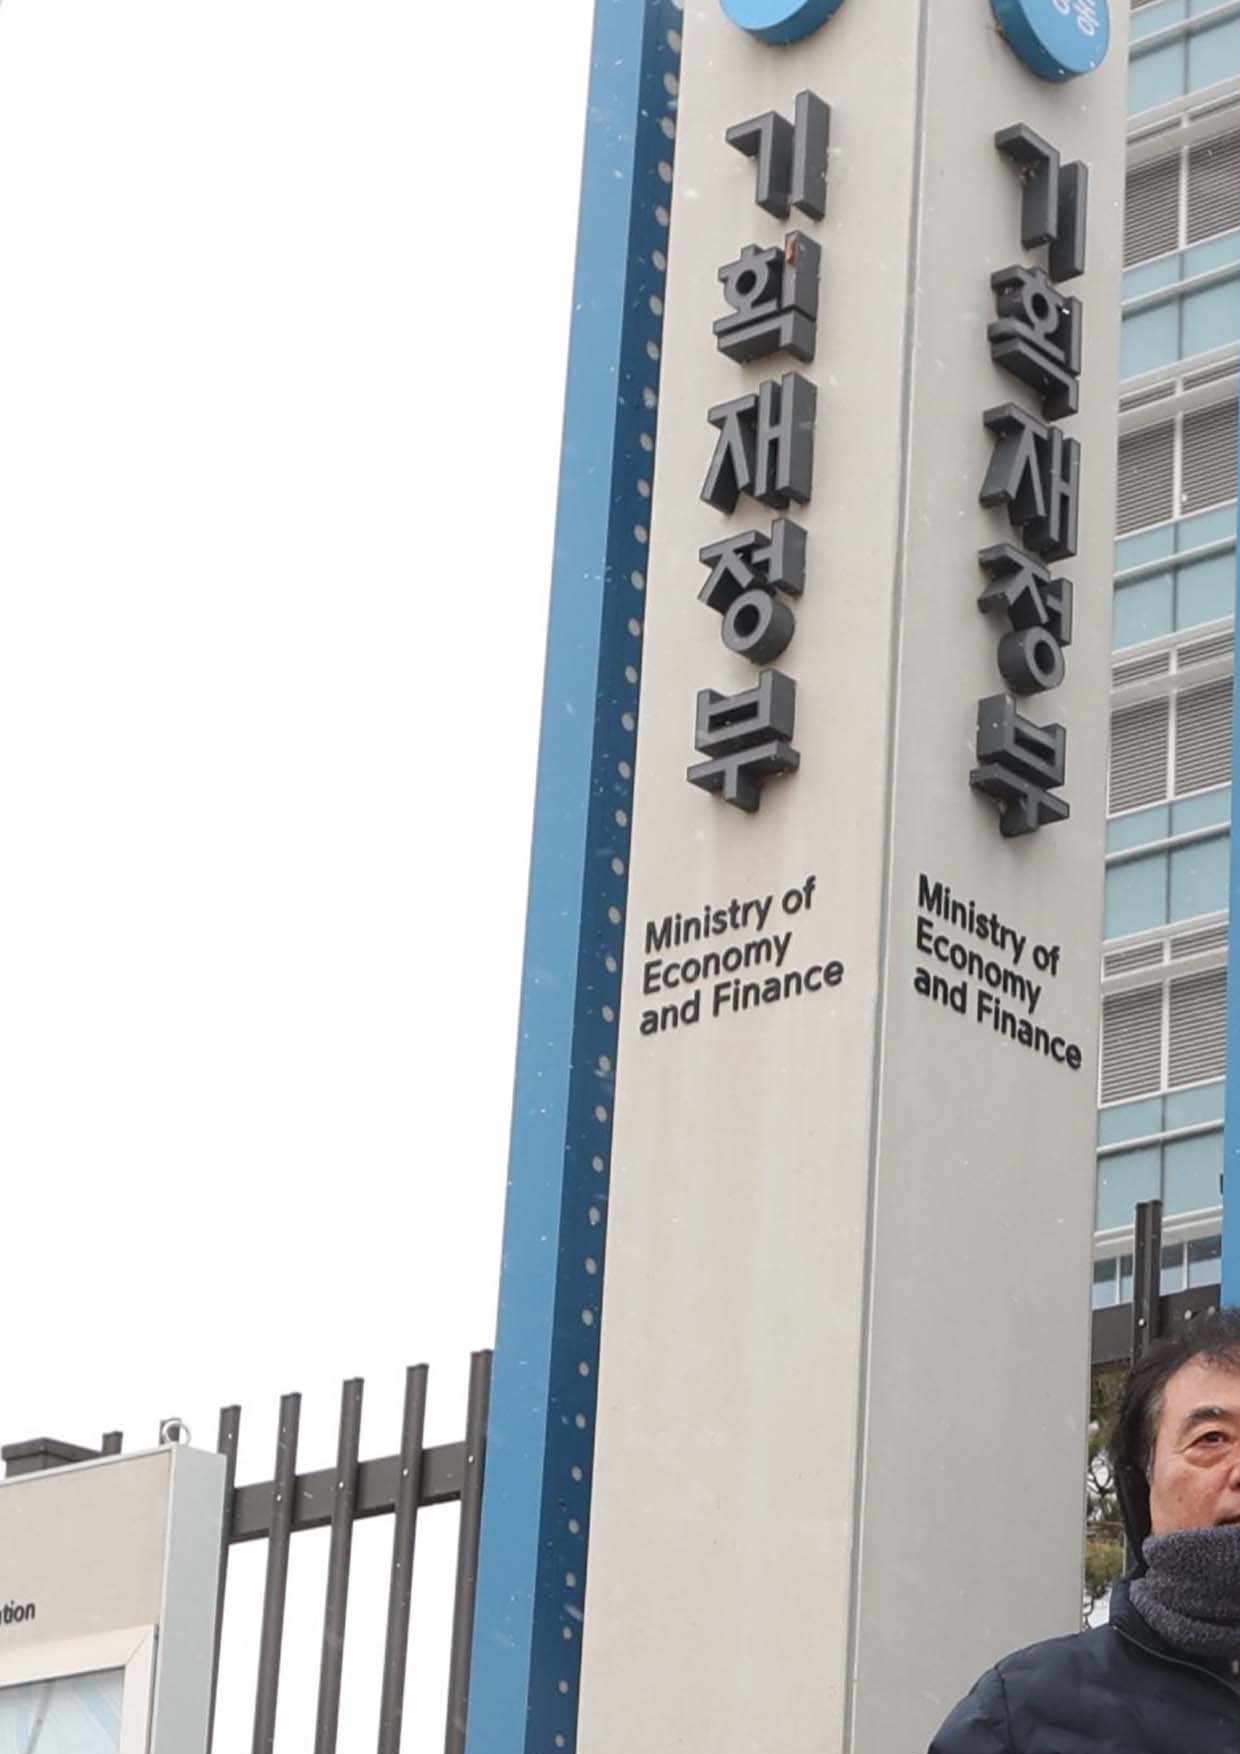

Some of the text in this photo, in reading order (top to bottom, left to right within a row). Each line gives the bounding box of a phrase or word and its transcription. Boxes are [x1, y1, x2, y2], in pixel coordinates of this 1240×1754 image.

[688, 89, 830, 812] 기획재정부
[970, 122, 1088, 836] 기획재정부
[643, 931, 792, 995] Economy
[644, 875, 816, 955] Ministry of
[916, 916, 1042, 1015] Economy
[918, 873, 1061, 978] Ministry of
[639, 959, 844, 1036] and Finance
[913, 965, 1082, 1070] and Finance
